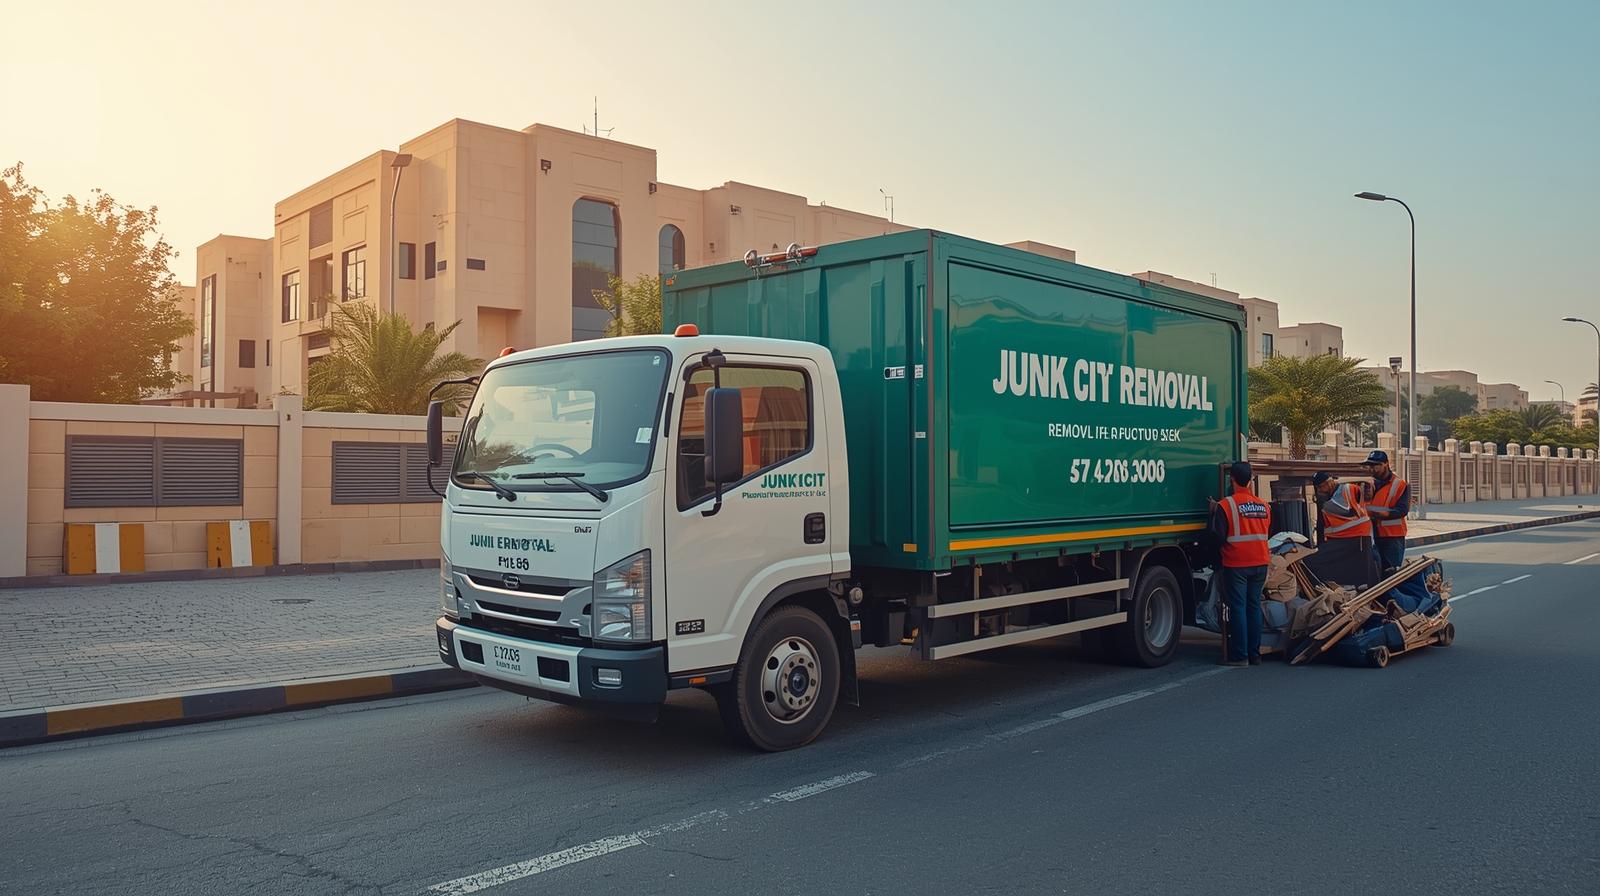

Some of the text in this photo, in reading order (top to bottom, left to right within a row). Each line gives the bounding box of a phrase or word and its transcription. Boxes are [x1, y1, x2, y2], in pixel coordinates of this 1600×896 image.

[992, 349, 1069, 400] JUNK
[1120, 365, 1213, 411] REMOVAL
[1048, 423, 1094, 439] REMOVL
